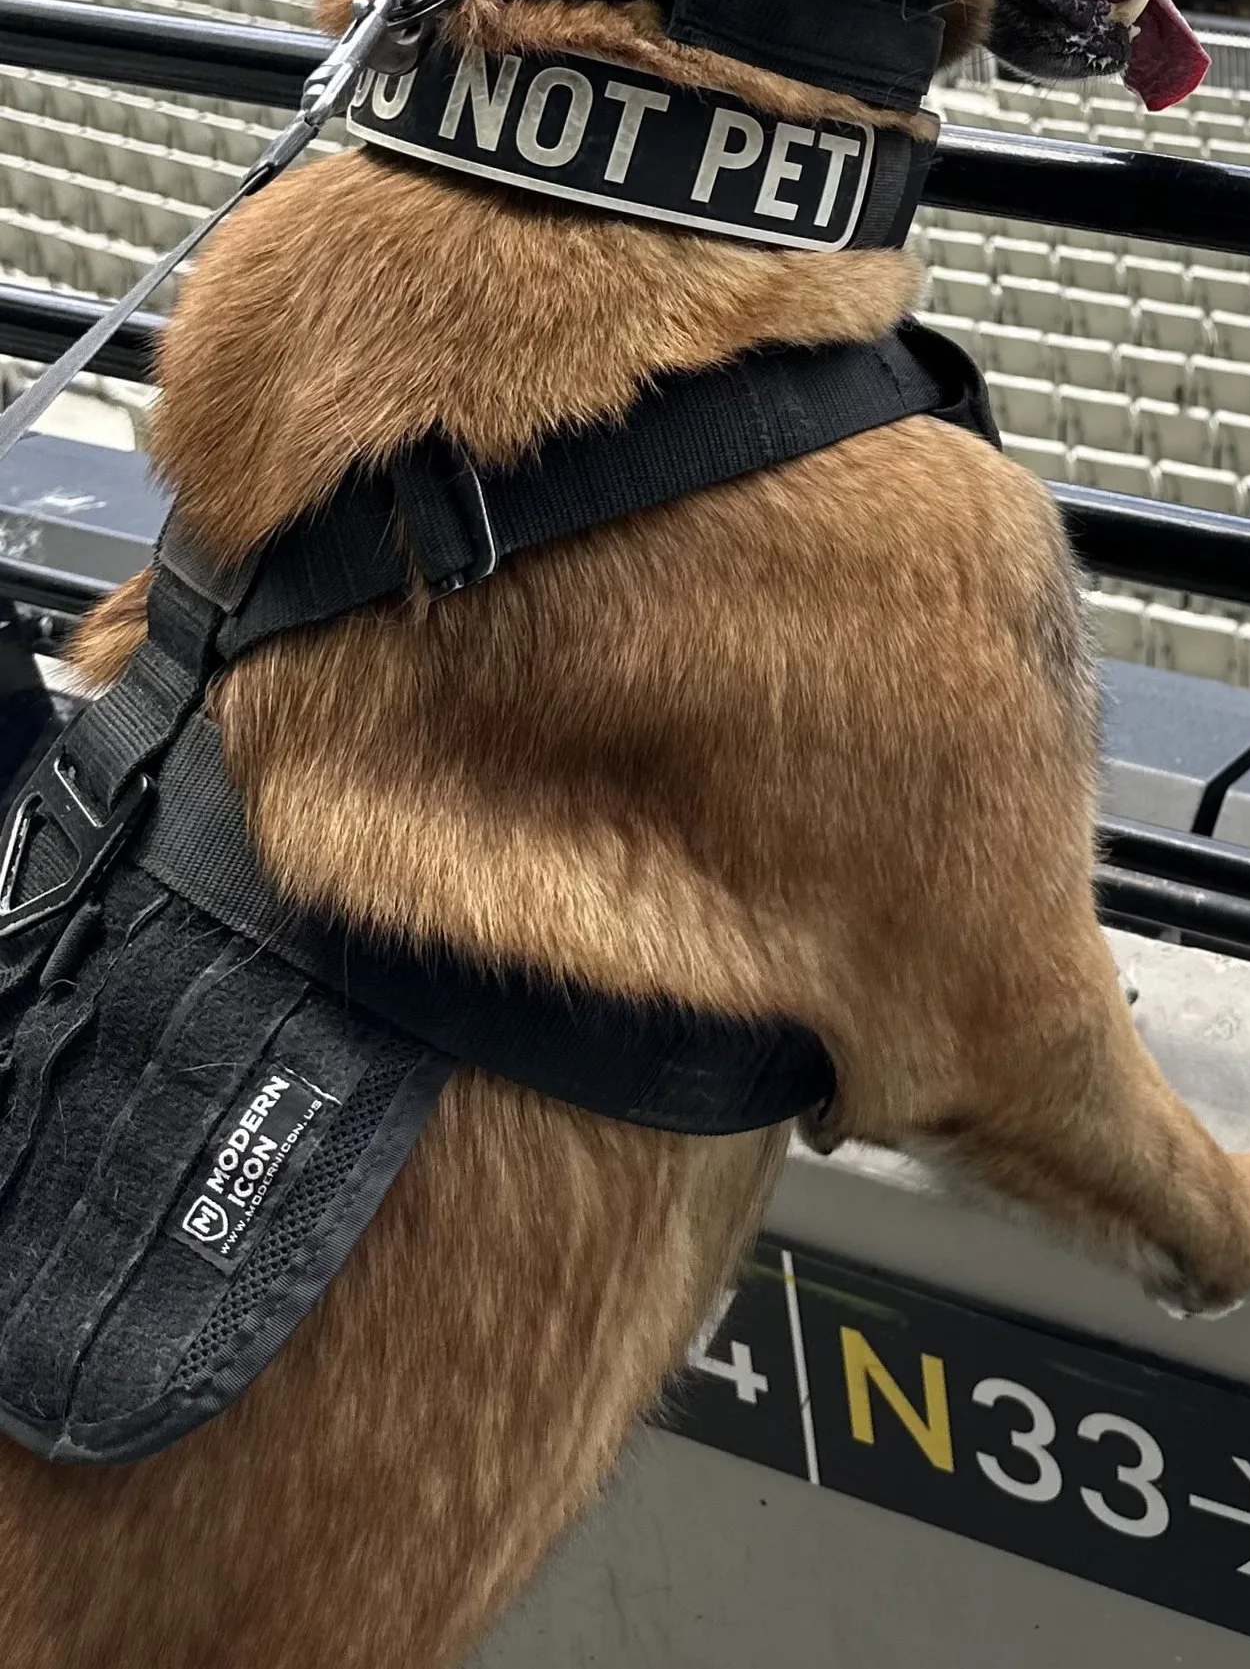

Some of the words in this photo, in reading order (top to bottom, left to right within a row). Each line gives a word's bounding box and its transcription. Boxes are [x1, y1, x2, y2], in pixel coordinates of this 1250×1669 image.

[438, 43, 671, 184] NOT
[690, 107, 862, 229] PET
[205, 1075, 291, 1195] MODERN
[226, 1134, 279, 1209] ICON
[839, 1324, 1171, 1539] N33
